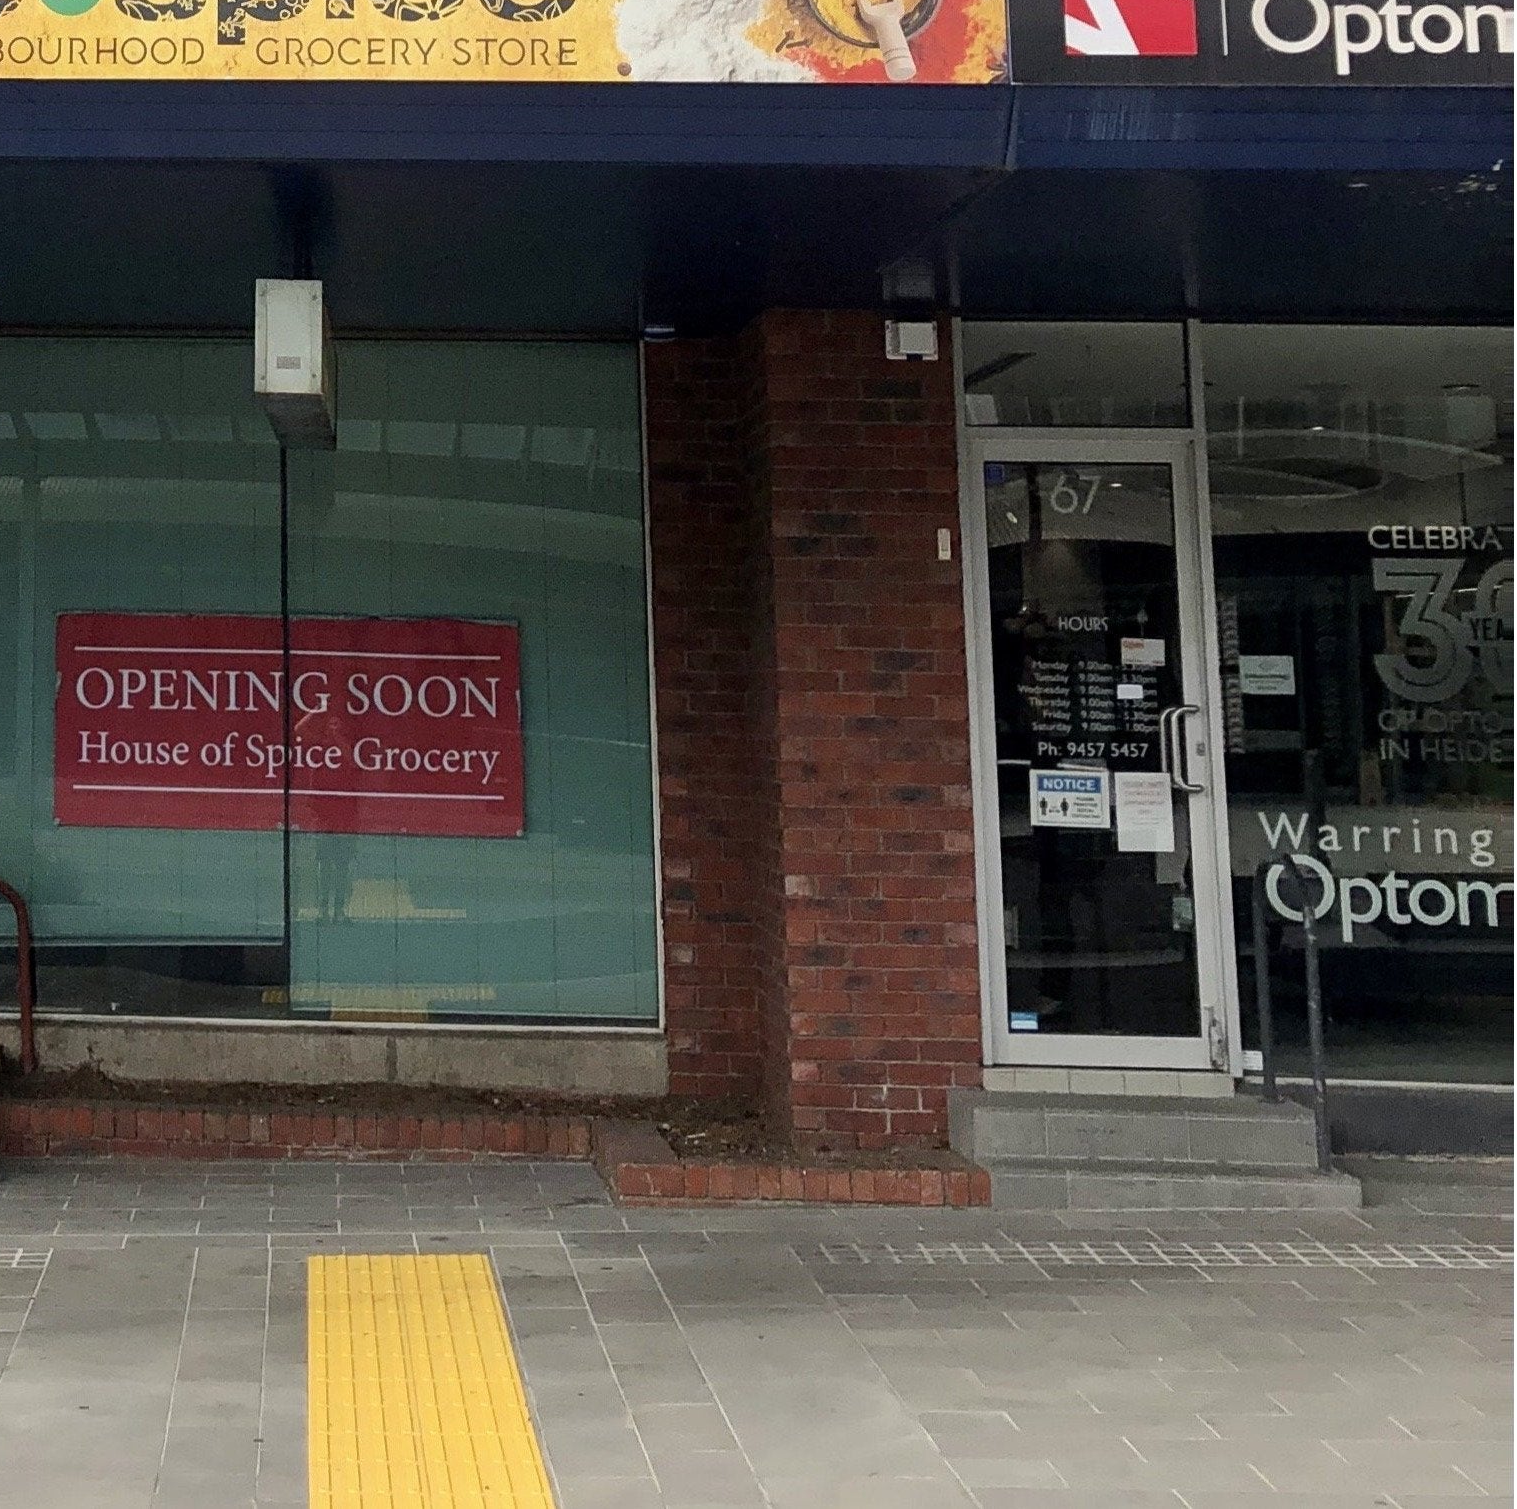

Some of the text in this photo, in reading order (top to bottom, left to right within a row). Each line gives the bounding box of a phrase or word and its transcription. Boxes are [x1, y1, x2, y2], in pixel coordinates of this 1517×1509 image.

[255, 36, 436, 66] GROCERY
[453, 37, 578, 66] STORE
[1049, 473, 1103, 515] 67
[1367, 525, 1503, 550] CELEBRA
[1058, 616, 1109, 632] HOURS
[1031, 660, 1069, 672] Monday
[1033, 672, 1069, 684] Tuesday
[75, 667, 500, 718] OPENING SOON
[1042, 709, 1071, 721] Friday
[1031, 721, 1072, 733] Saturday
[78, 730, 501, 785] House of Spice Grocery
[1037, 741, 1149, 758] Ph: 9457 5457
[1379, 737, 1410, 760] IN
[1042, 777, 1097, 791] NOTICE
[1257, 811, 1496, 867] Warring
